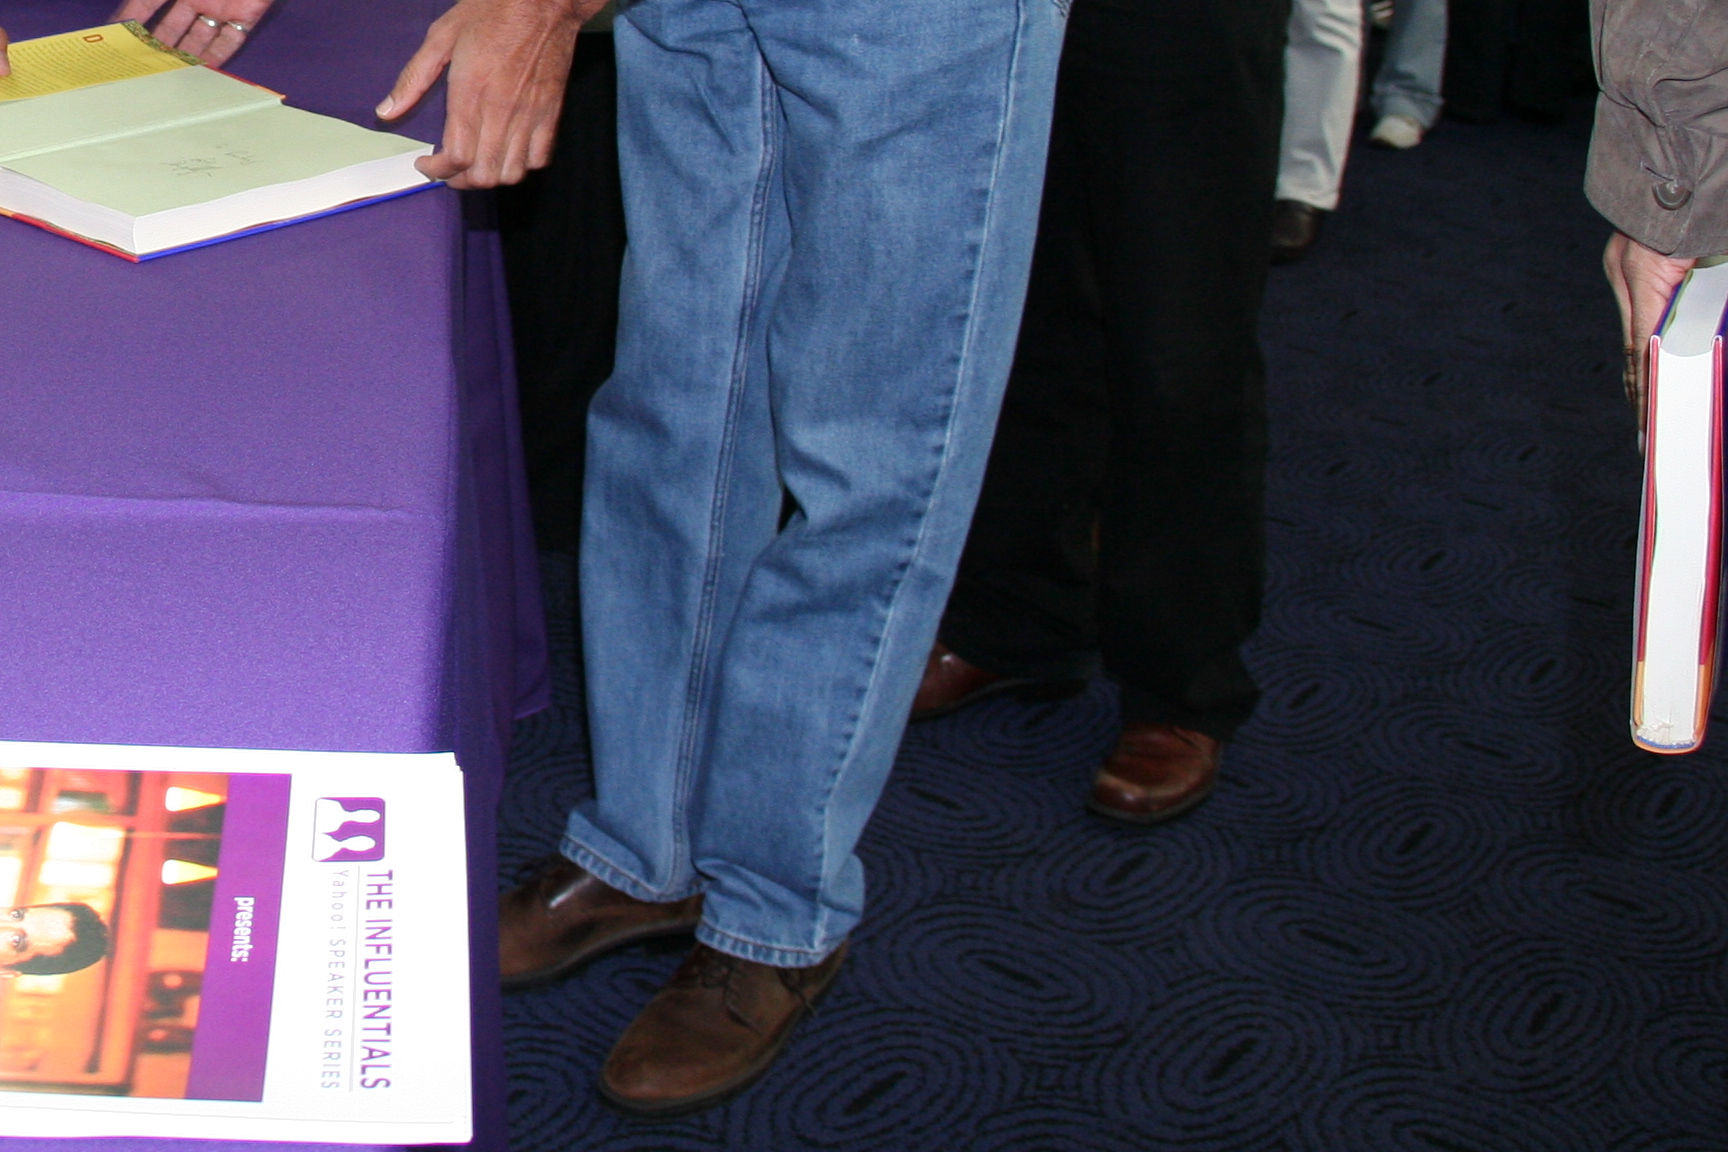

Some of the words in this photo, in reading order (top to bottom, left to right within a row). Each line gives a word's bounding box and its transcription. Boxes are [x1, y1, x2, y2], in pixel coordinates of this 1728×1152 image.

[330, 869, 349, 929] Yahoo!
[365, 869, 393, 910] THE
[230, 896, 256, 962] presents:
[324, 939, 346, 1019] SPEAKER
[360, 919, 393, 1089] INFLUENTIALS
[321, 1029, 343, 1089] SERIES
